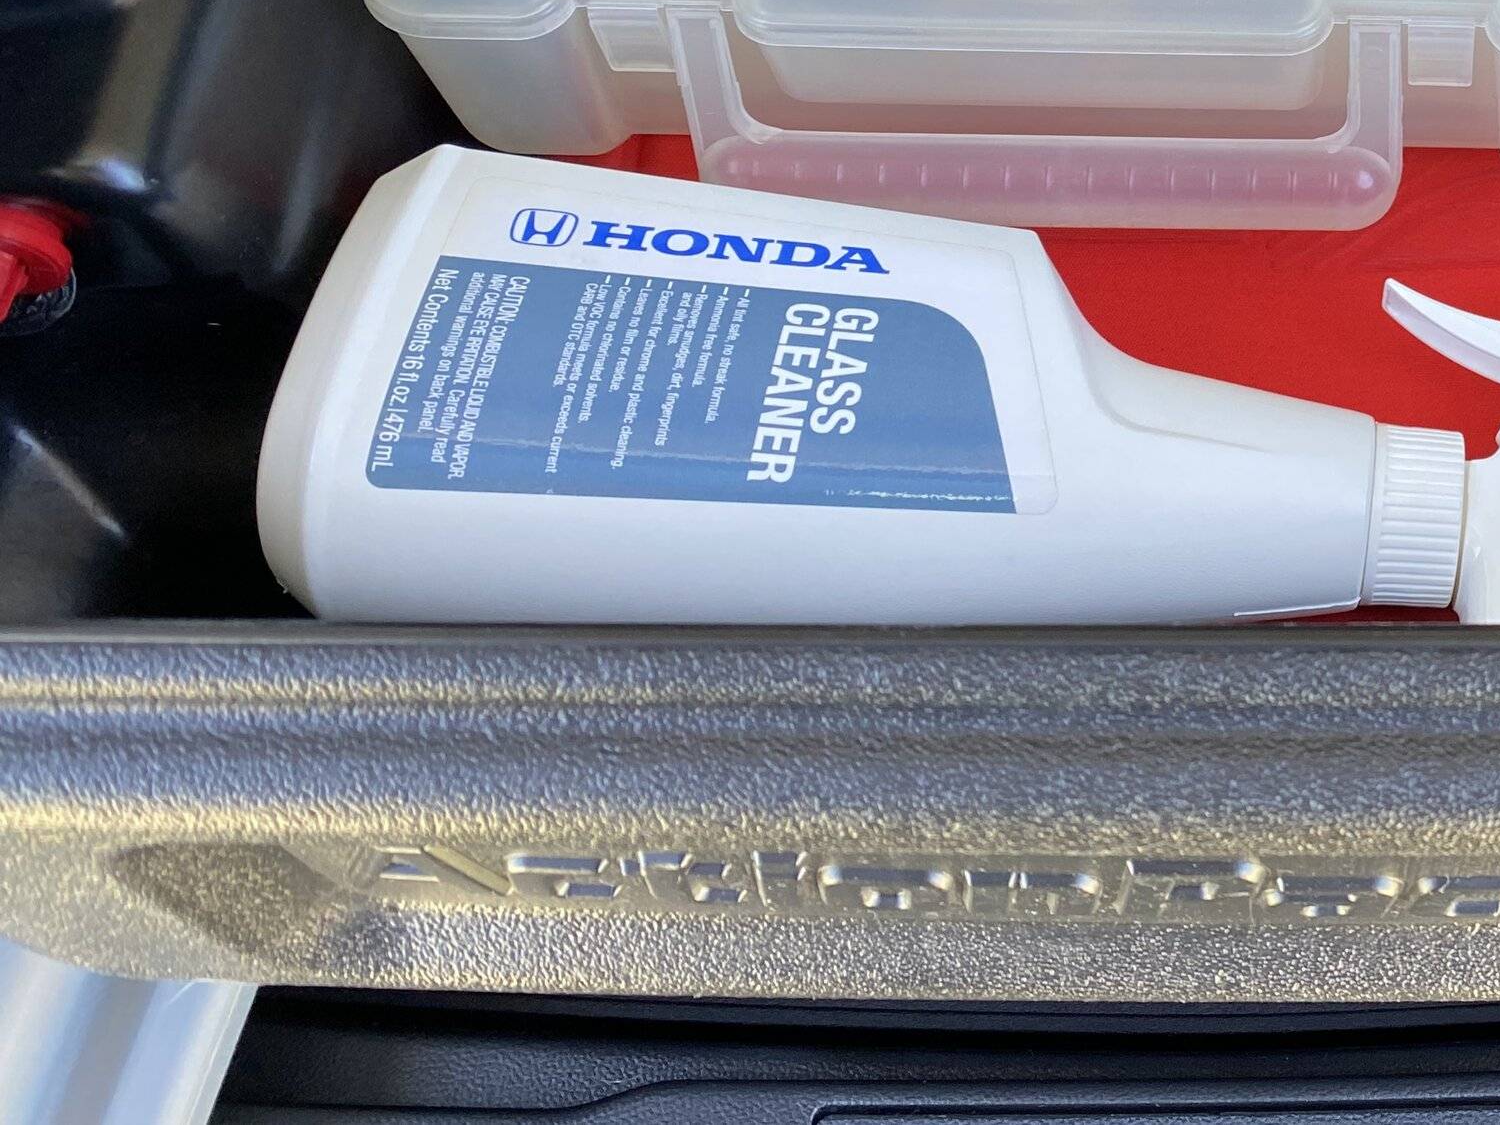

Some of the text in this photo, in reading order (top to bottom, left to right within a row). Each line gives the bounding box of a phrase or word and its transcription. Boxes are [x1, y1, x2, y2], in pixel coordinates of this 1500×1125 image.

[431, 269, 459, 290] Net
[582, 220, 890, 274] HONDA
[402, 355, 425, 369] 16
[408, 295, 449, 352] Contents
[417, 272, 485, 433] additional warnings on back panel.
[430, 274, 507, 463] MAY CAUSE EYE IRRITATION. Carefully read
[447, 276, 531, 479] CAUTION: COMBUSTIBLE LIQUID AND VAPOR.
[545, 284, 611, 473] Low VOC formula meets or exceeds current
[553, 283, 599, 387] CARB and OTC standards.
[577, 287, 631, 423] Contains no chlorinated solvents.
[608, 289, 652, 393] Leaves no film or residue.
[610, 291, 673, 469] Excellent for chrome and plastic cleaning.
[655, 293, 708, 446] Removes smudges, dirt, fingerprints
[667, 292, 693, 346] and oily films.
[692, 295, 729, 387] Ammonia free formula.
[705, 297, 750, 423] All tint safe, no streak formula.
[810, 308, 879, 434] GLASS
[747, 303, 831, 483] CLEANER
[372, 445, 393, 471] mL
